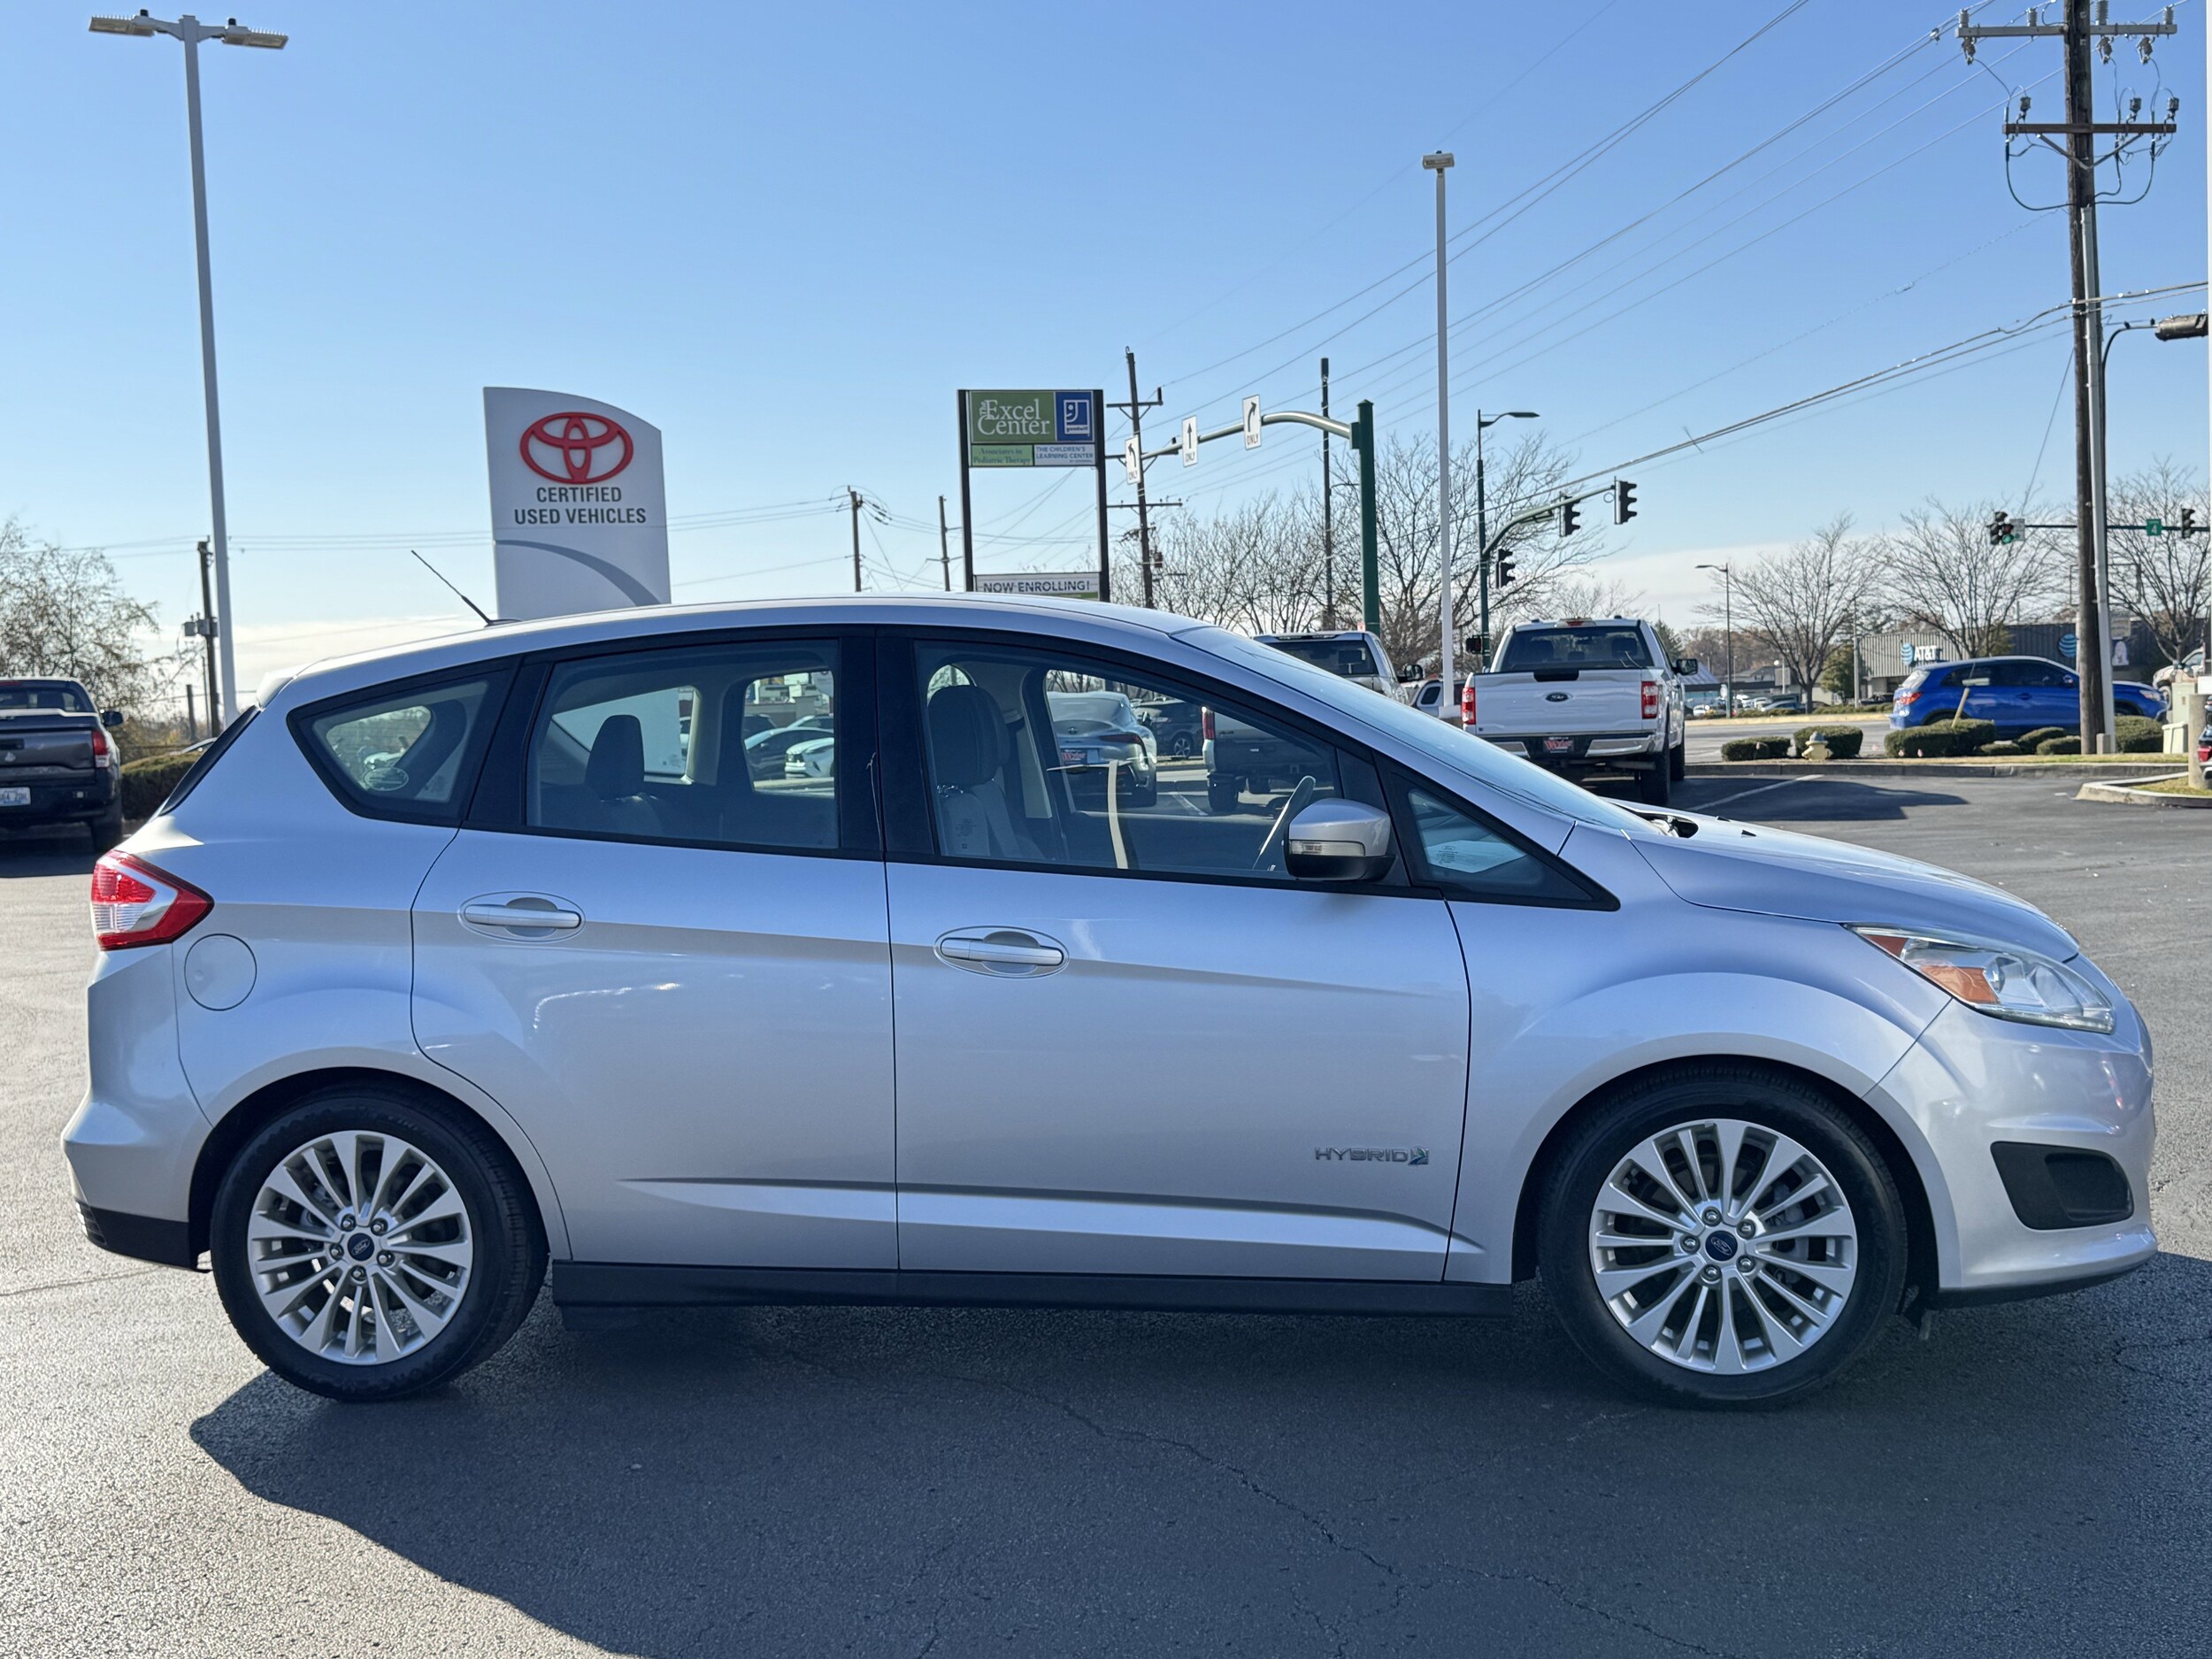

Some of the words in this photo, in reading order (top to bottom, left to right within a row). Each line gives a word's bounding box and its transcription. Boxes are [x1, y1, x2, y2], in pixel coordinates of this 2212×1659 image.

[983, 398, 1041, 420] Excel
[978, 415, 1051, 435] Center
[1247, 433, 1259, 445] ONLY
[1186, 451, 1195, 463] ONLY
[536, 487, 622, 503] CERTIFIED
[514, 509, 561, 525] USED
[565, 507, 647, 524] VEHICLES
[983, 581, 1014, 593] NOW
[1018, 580, 1090, 593] ENROLLING!
[1914, 645, 1937, 661] AT&T
[1315, 1147, 1409, 1163] HYBRID
